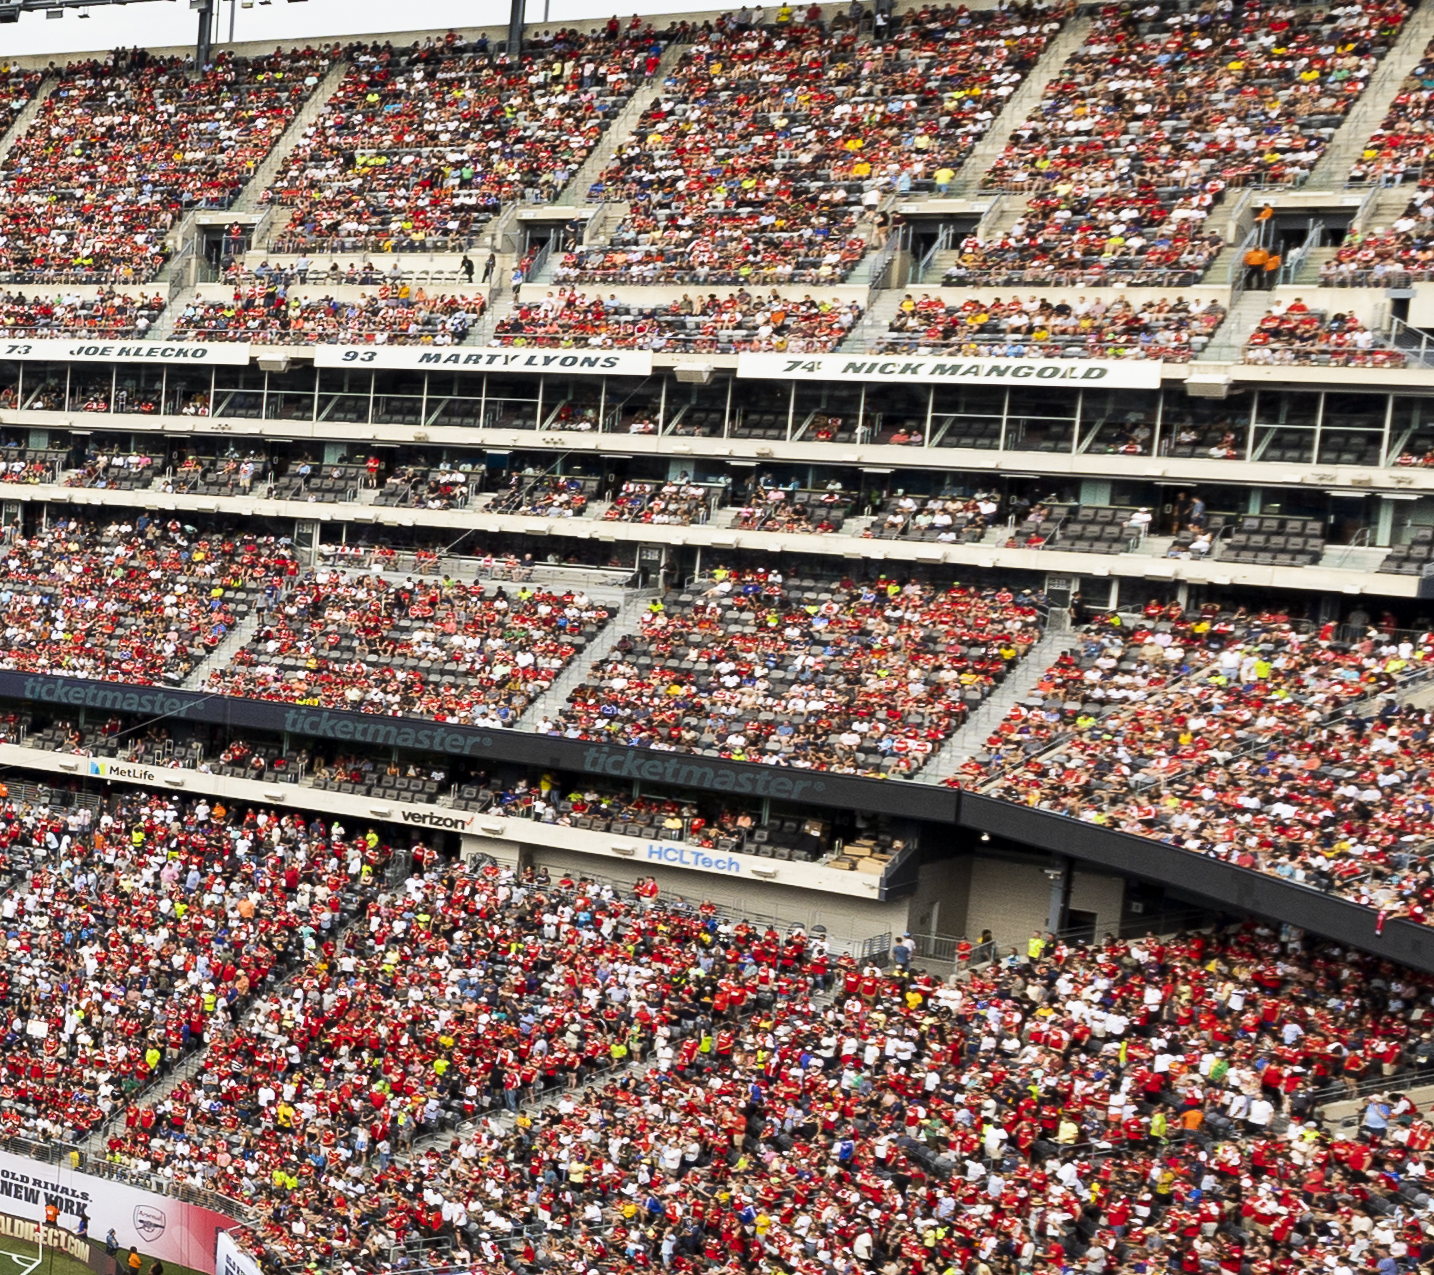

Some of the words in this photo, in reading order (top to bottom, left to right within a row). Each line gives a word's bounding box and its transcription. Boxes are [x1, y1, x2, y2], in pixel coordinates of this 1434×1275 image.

[6, 345, 33, 355] 73
[69, 345, 112, 356] JOE
[117, 346, 209, 358] KLECKO
[341, 351, 378, 362] 93
[418, 352, 521, 366] MARTY
[523, 355, 621, 369] LYONS
[782, 360, 823, 372] 74
[841, 362, 926, 376] NICK
[928, 363, 1110, 380] MANGOLD
[24, 677, 194, 716] ticketmaster
[284, 709, 482, 755] ticketmaster
[109, 765, 155, 781] MetLife
[583, 747, 812, 798] ticketmaster
[401, 808, 466, 831] verizon
[648, 844, 741, 873] HCLTech
[0, 1180, 41, 1206] NEW
[1, 1169, 32, 1185] OLD
[34, 1177, 93, 1203] RIVALS.
